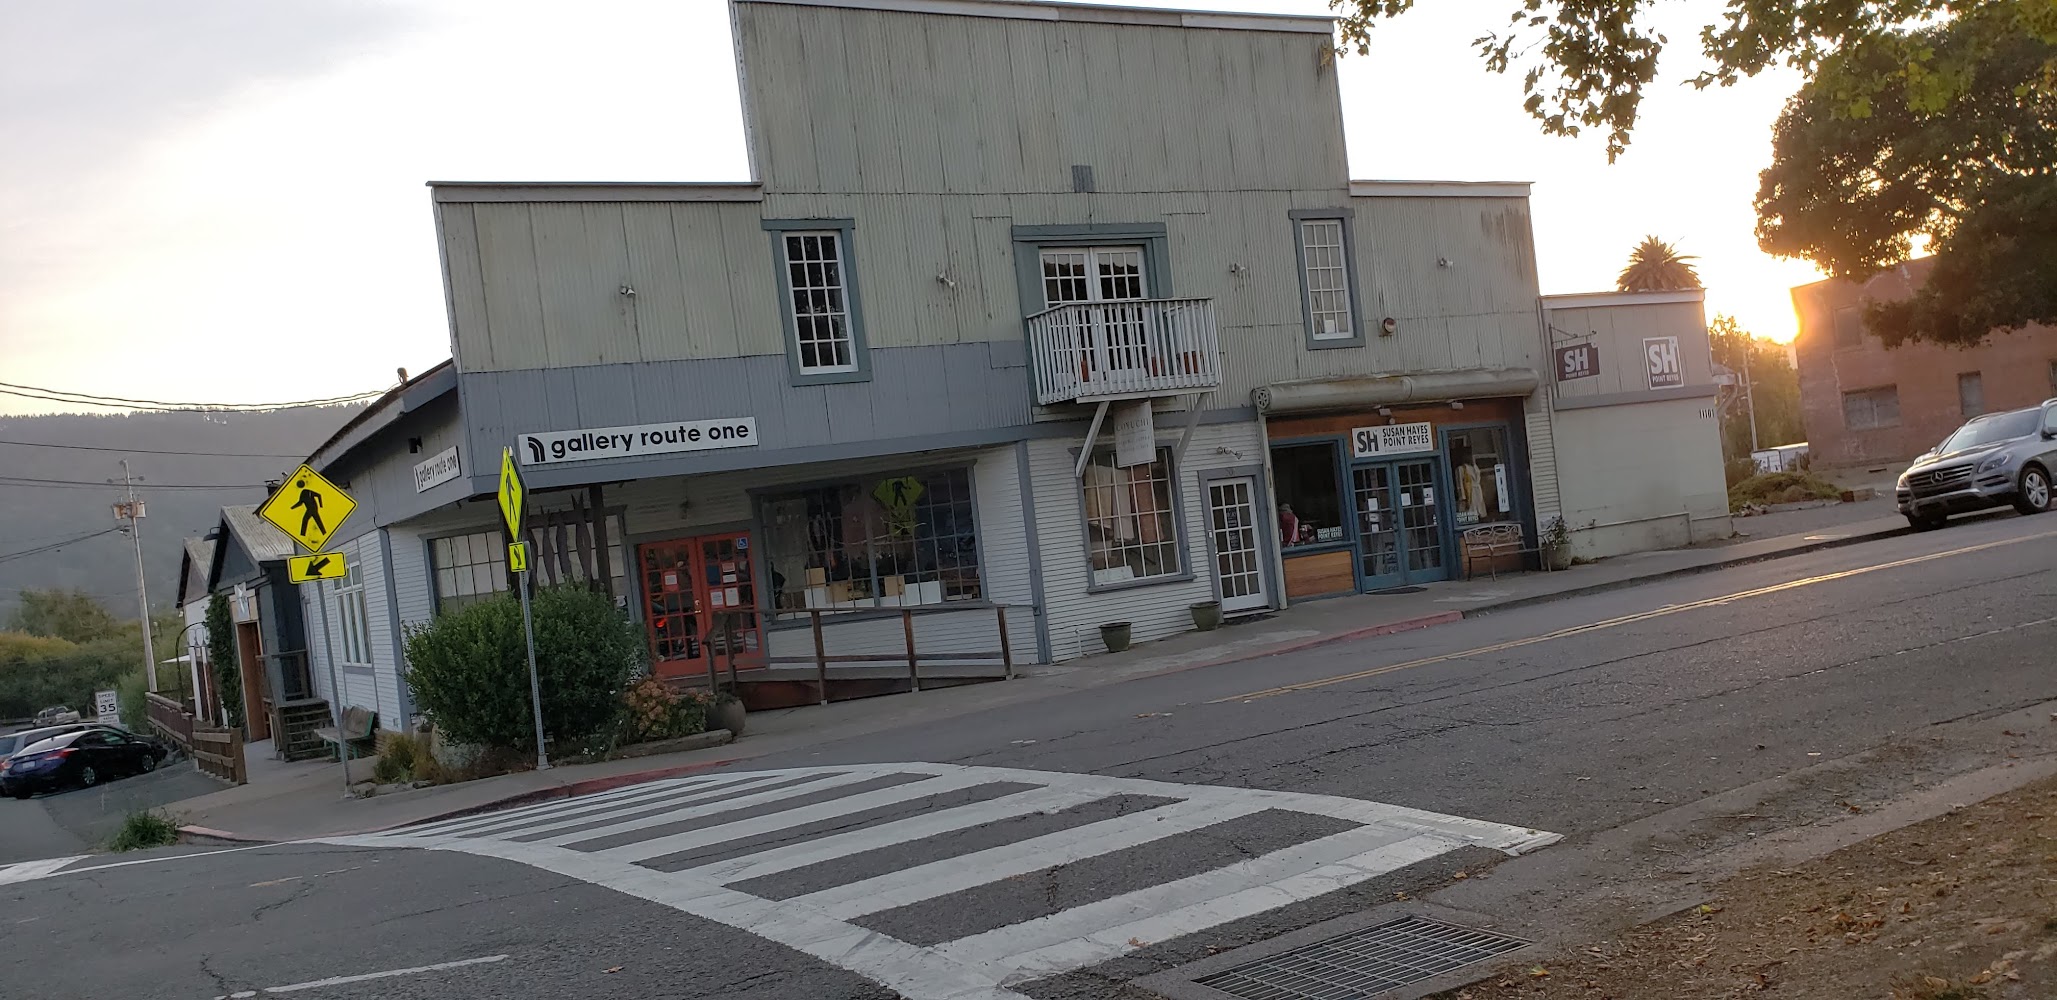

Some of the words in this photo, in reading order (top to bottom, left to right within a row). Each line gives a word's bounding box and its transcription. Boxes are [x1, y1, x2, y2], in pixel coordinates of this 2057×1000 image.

[1564, 347, 1589, 373] SH
[1648, 343, 1678, 375] SH
[1652, 375, 1666, 383] POINT
[1666, 373, 1679, 382] REYES
[551, 433, 634, 459] gallery
[640, 425, 701, 447] route
[708, 424, 749, 440] one
[1356, 430, 1379, 453] SH
[1382, 426, 1405, 438] SUSAN
[1406, 424, 1428, 436] HAYES
[1383, 436, 1406, 447] POINT
[1408, 434, 1429, 445] REYES
[419, 464, 436, 488] gallery
[434, 457, 447, 476] route
[447, 454, 457, 471] one
[100, 703, 116, 713] 35
